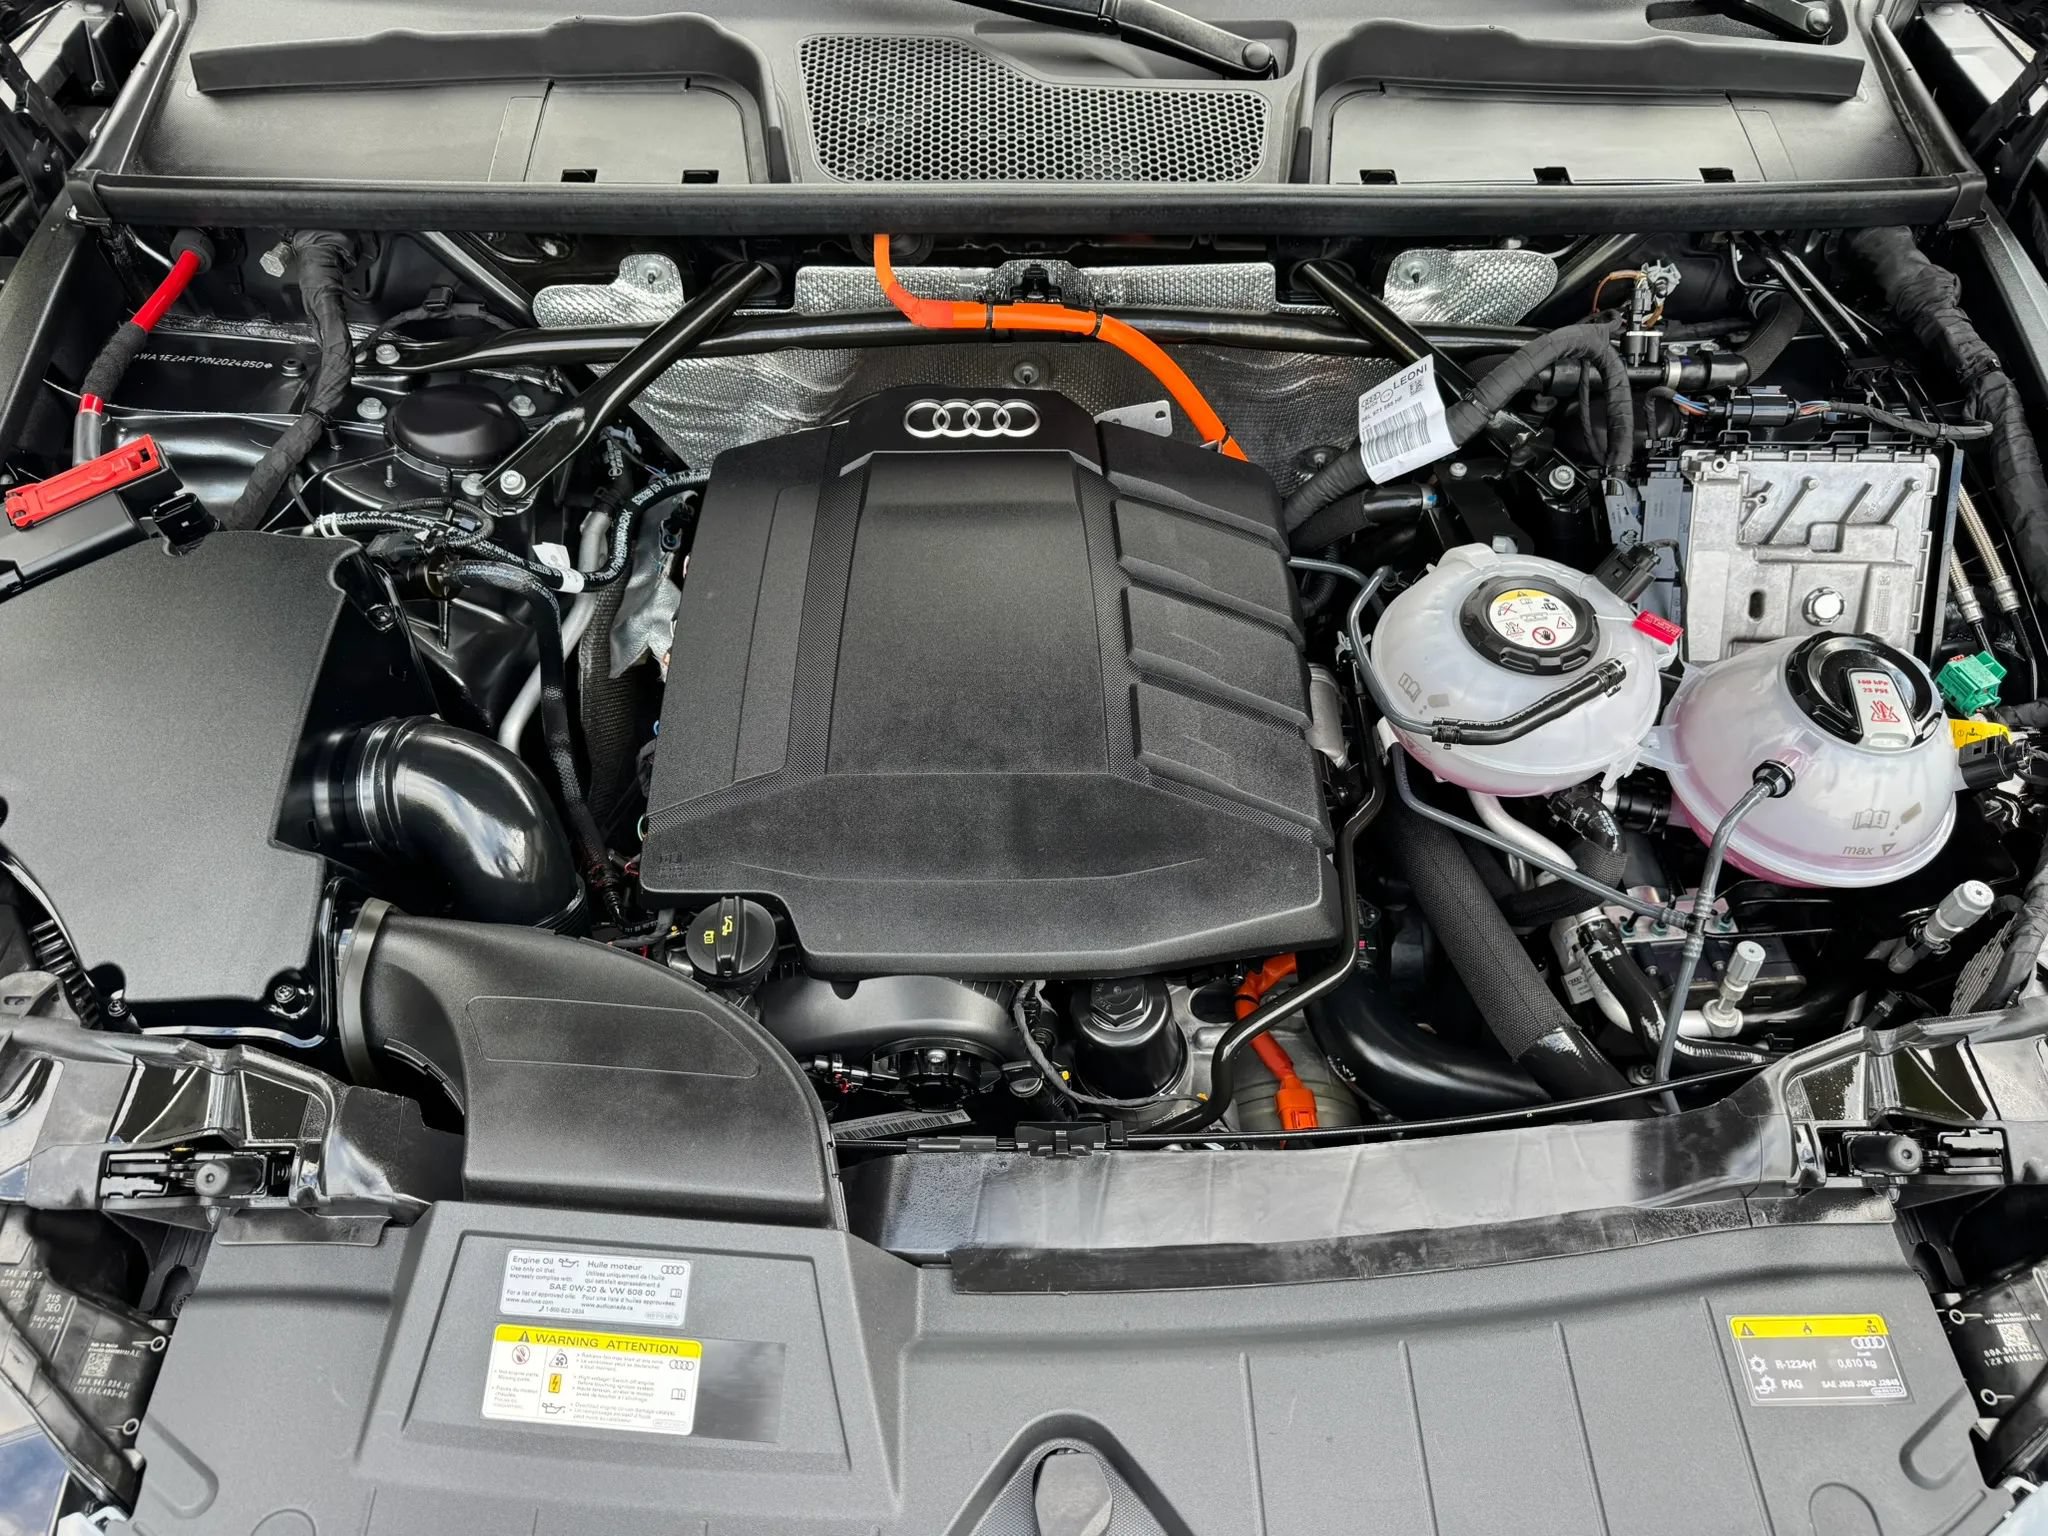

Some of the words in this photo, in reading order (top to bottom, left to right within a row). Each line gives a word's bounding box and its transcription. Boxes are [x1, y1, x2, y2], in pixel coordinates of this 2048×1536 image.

[1393, 363, 1427, 389] LEONI
[1842, 846, 1874, 855] max
[513, 1255, 541, 1265] Engine
[587, 1260, 608, 1269] Huile
[610, 1263, 642, 1271] moteur
[549, 1283, 567, 1291] SAE
[569, 1284, 597, 1294] 0W-20
[599, 1286, 606, 1294] &
[609, 1287, 625, 1295] VW
[536, 1333, 599, 1348] WARNING
[606, 1337, 679, 1355] ATTENTION
[1774, 1359, 1817, 1371] R-1234yf
[1863, 1358, 1878, 1370] kg
[1781, 1379, 1804, 1390] PAG
